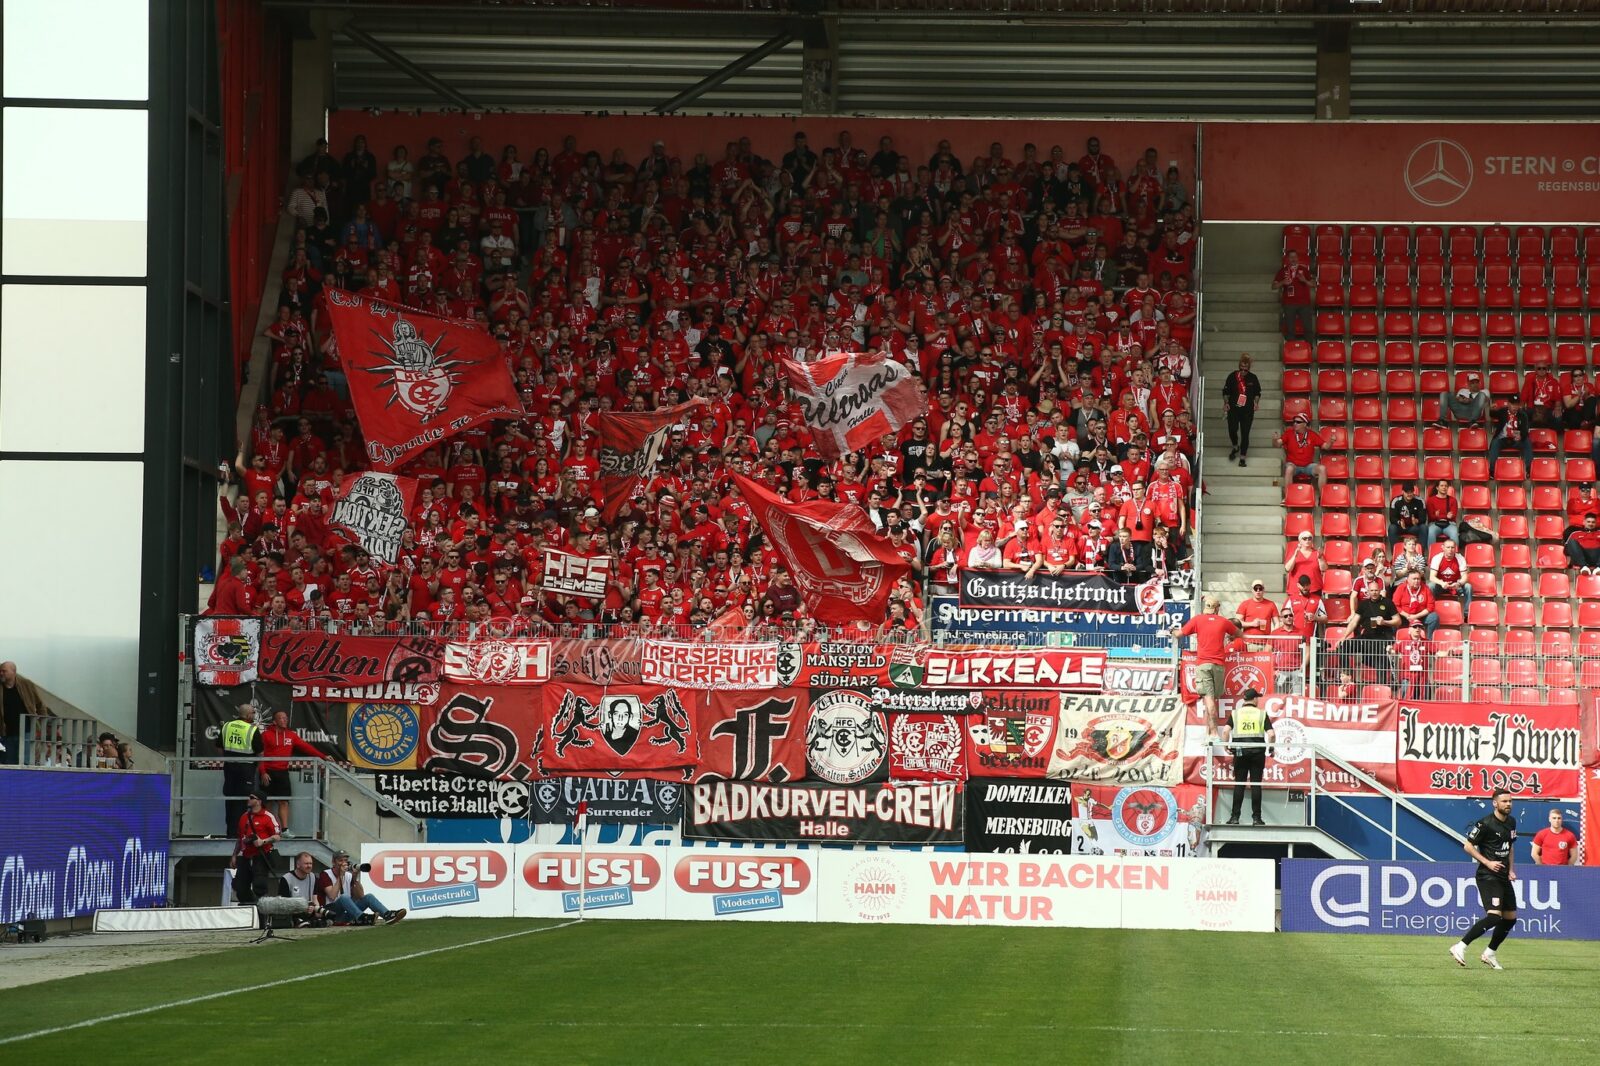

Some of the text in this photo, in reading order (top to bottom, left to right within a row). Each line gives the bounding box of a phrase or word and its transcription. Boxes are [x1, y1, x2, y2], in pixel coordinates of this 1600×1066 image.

[1484, 156, 1556, 175] STERN
[544, 552, 607, 581] HFC
[544, 574, 606, 593] CHEMIE
[966, 577, 1127, 606] Goitzschefront
[262, 634, 384, 683] Köthen
[820, 643, 874, 655] SEKTION
[806, 654, 886, 669] MANSFELD
[927, 656, 1104, 686] SURREALE
[810, 672, 878, 688] SÜDHARZ
[1111, 669, 1173, 692] RWF
[871, 687, 967, 711] Petersberg
[1063, 697, 1178, 713] FANCLUB
[1026, 716, 1047, 725] HFC
[1265, 698, 1380, 724] CHEMIE
[1064, 728, 1078, 738] 19
[1242, 722, 1256, 731] 261
[229, 735, 242, 745] 415
[355, 726, 414, 760] LOKOMOTIVE
[1400, 707, 1578, 766] Leuna-Löwen
[452, 775, 502, 793] Crew
[1431, 768, 1542, 794] seit 1984
[984, 784, 1072, 804] DOMFALKEN
[586, 807, 653, 817] Surrender
[694, 782, 956, 831] BADKURVEN-CREW
[800, 821, 849, 837] Halle
[985, 817, 1073, 837] MERSEBURG
[1077, 835, 1084, 852] 2
[1176, 843, 1186, 857] 11
[383, 855, 498, 882] FUSSL
[538, 858, 650, 885] FUSSL
[688, 861, 800, 889] FUSSL
[929, 861, 1170, 891] WIR BACKEN
[416, 887, 472, 904] Modestraße
[854, 883, 896, 894] HAHN
[1195, 890, 1238, 902] HAHN
[721, 893, 776, 909] Modestraße
[929, 894, 1054, 921] NATUR
